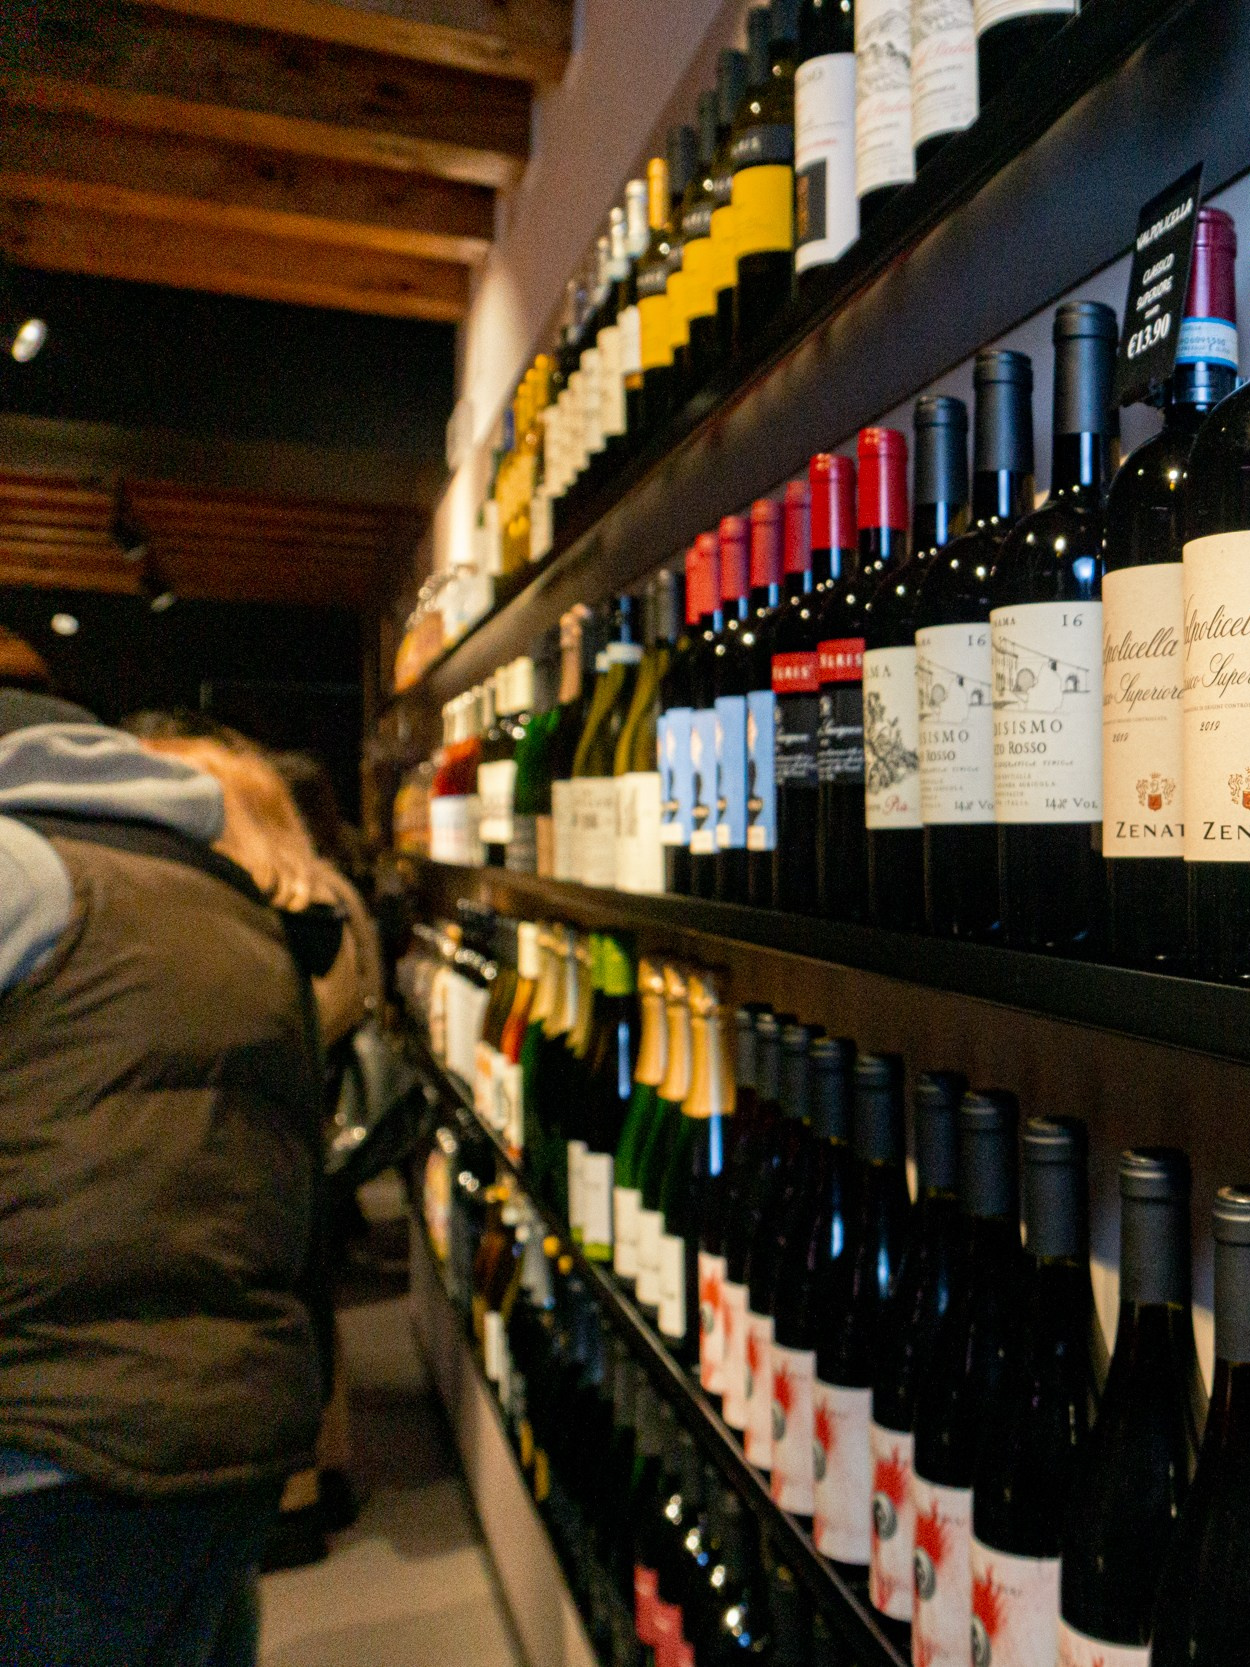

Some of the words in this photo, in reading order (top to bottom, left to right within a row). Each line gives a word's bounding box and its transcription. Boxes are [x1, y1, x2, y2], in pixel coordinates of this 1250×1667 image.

[1127, 311, 1172, 360] €13.90
[1114, 673, 1184, 713] Superiore
[1200, 720, 1221, 732] 2019
[1008, 740, 1047, 756] ROSSO
